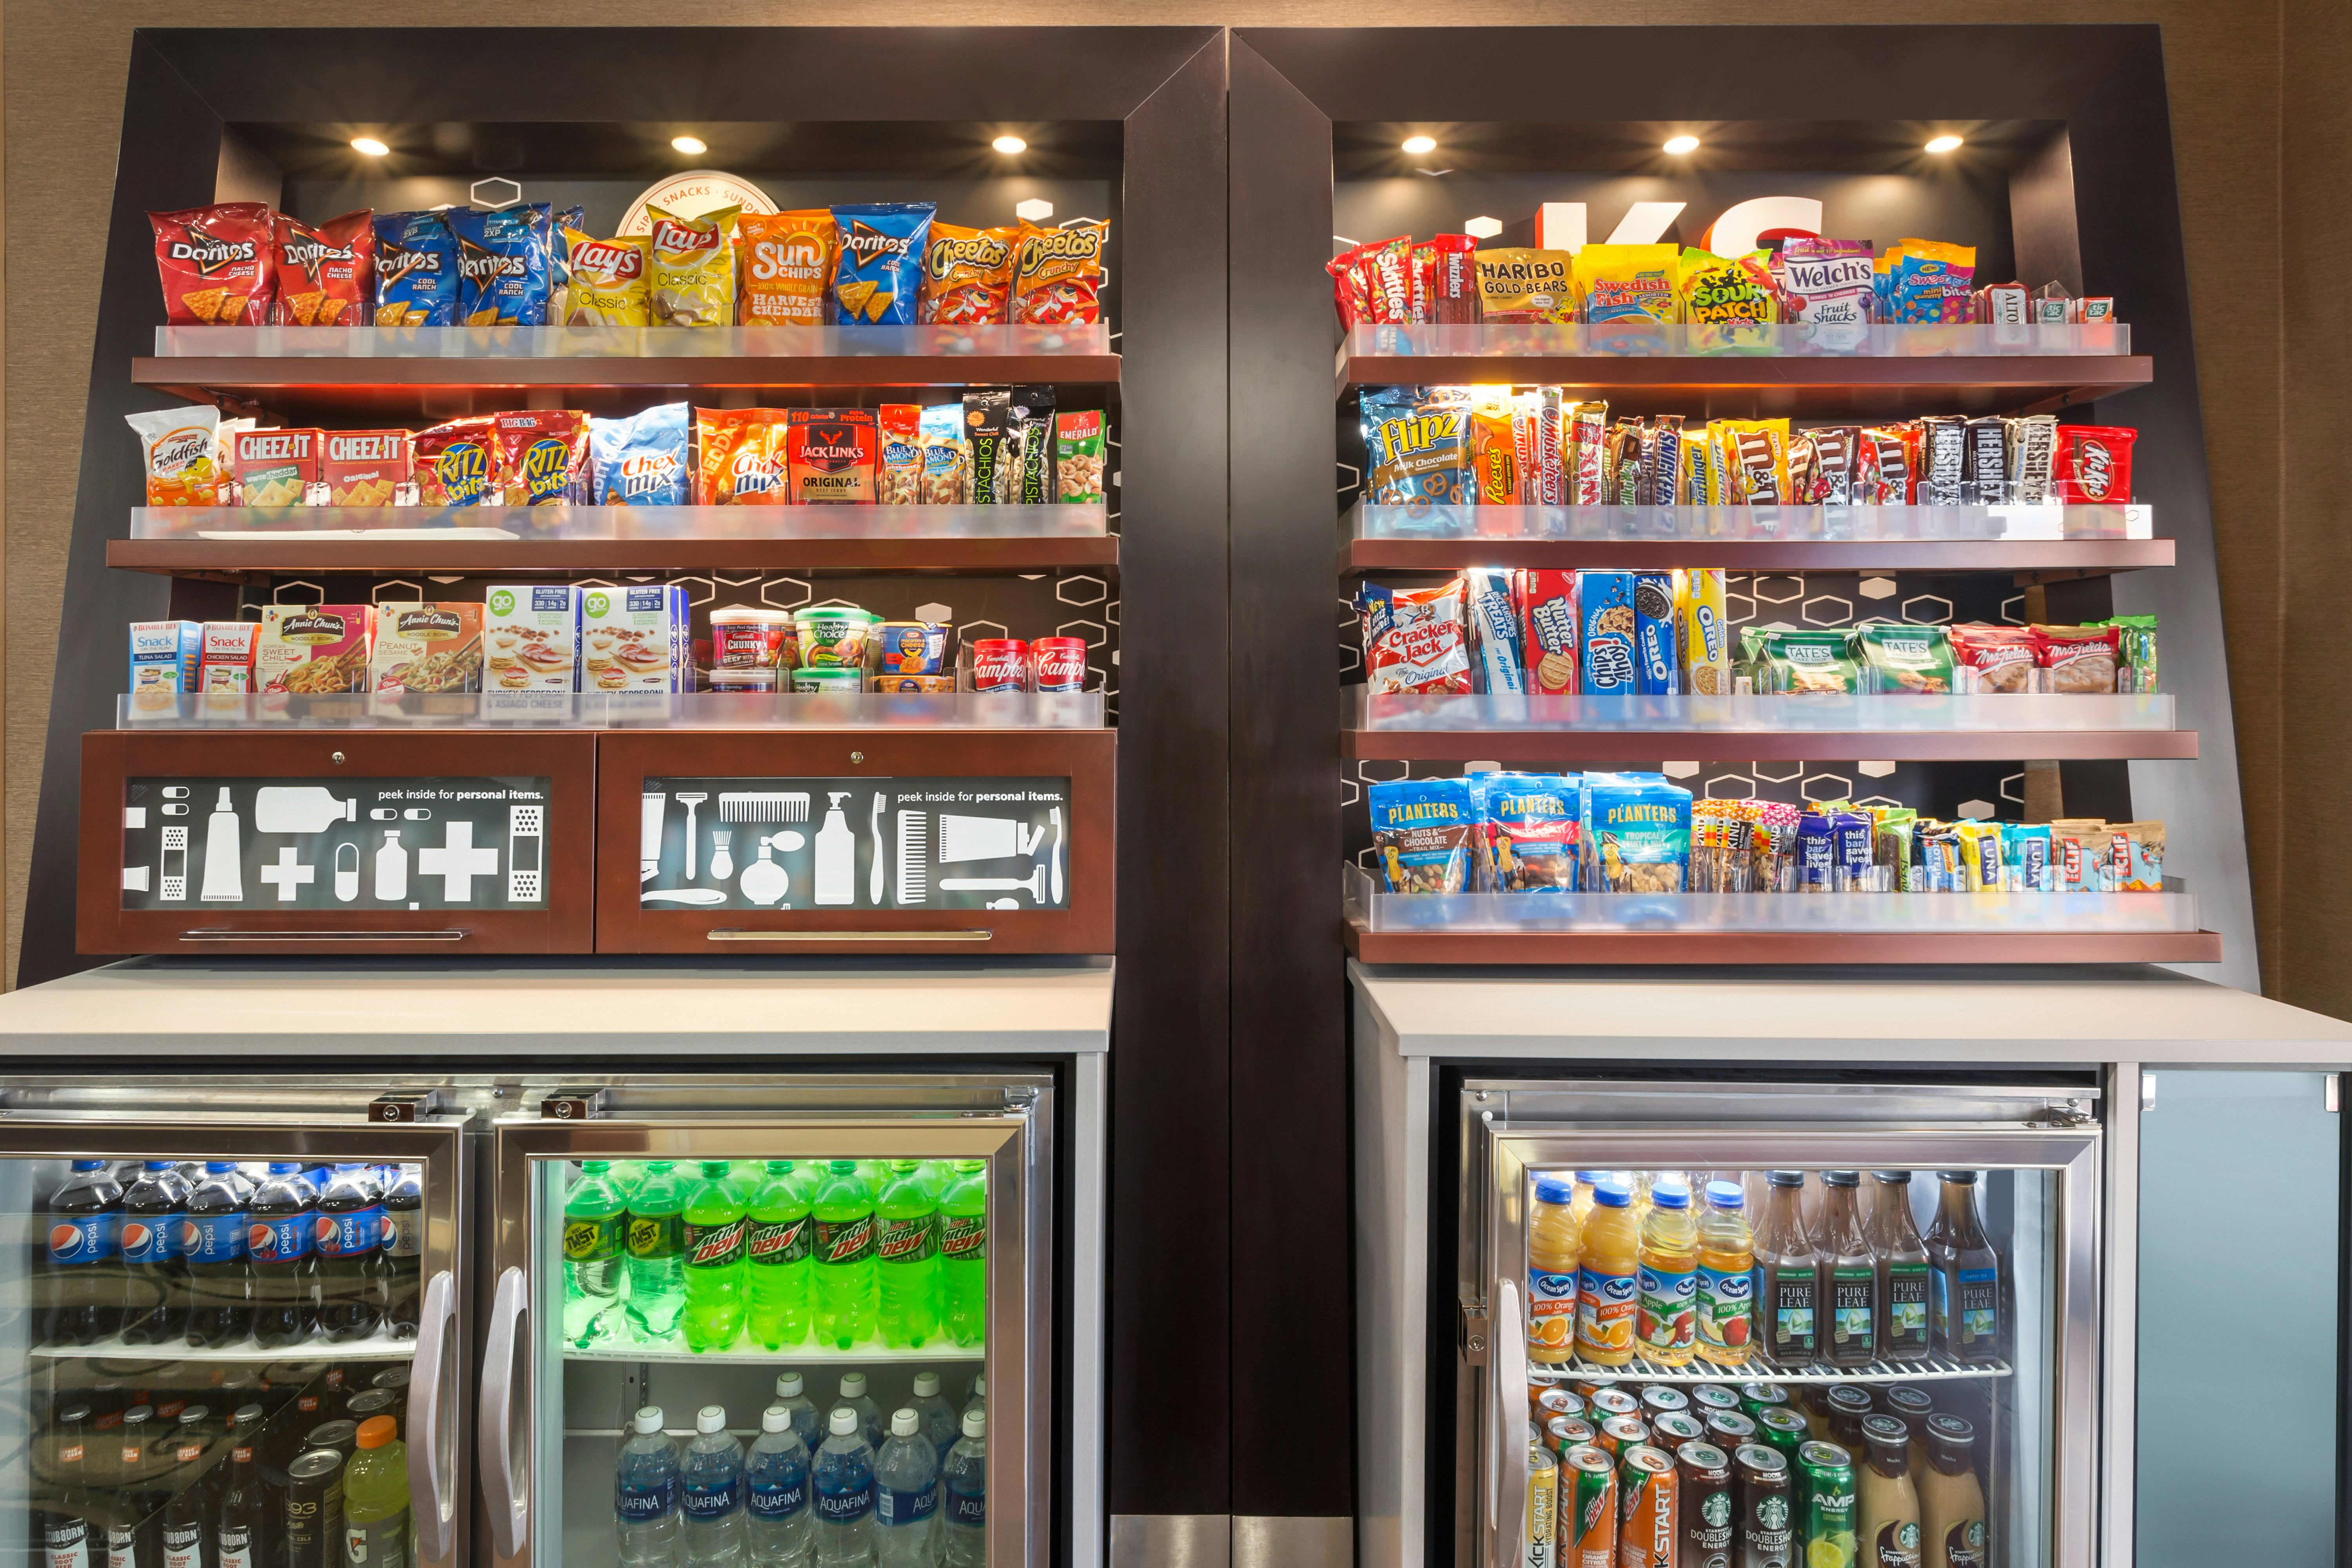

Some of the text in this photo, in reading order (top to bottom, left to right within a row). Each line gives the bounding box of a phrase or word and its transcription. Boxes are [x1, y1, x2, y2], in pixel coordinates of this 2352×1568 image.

[664, 187, 710, 205] SNACKS
[172, 243, 254, 261] Doritos
[842, 234, 910, 254] Doritos
[286, 245, 353, 265] Doritos
[573, 243, 639, 277] Lay's
[1022, 231, 1096, 275] Cheetos
[779, 267, 821, 279] CHIPS
[1040, 262, 1078, 279] Crunchy
[1449, 253, 1463, 298] Twizzlers
[1481, 263, 1564, 279] HARIBO
[1789, 261, 1871, 288] Welch's
[658, 273, 707, 286] Classic
[1376, 253, 1405, 319] Skittles
[1485, 281, 1567, 294] GOLD-BEARS
[1595, 278, 1671, 292] Swedish
[799, 285, 818, 293] GRAIN
[1696, 285, 1761, 305] SOUR
[1923, 287, 1942, 295] mini
[753, 294, 822, 307] HARVEST
[1595, 293, 1635, 307] Fish
[1821, 303, 1851, 314] Fruit
[753, 306, 822, 318] CHEDDAR
[1697, 302, 1766, 323] PATCH
[1814, 311, 1857, 324] Snacks
[1060, 428, 1097, 440] EMERALD
[1379, 413, 1461, 463] Flipz
[799, 446, 864, 458] JACK LINK'S
[520, 445, 568, 480] RITZ
[623, 448, 679, 476] Chex
[1394, 454, 1457, 472] Milk Chocolate
[247, 467, 297, 482] WHITE cheddar
[803, 477, 860, 487] ORIGINAL
[1486, 447, 1505, 504] Reese's
[530, 473, 567, 494] bits
[493, 595, 512, 611] go
[1478, 593, 1508, 640] TREATS
[1491, 591, 1516, 637] RICE KRISPIES
[1587, 606, 1605, 637] ORIGINAL
[284, 618, 343, 630] Annie Chun's
[817, 622, 847, 632] Healthy
[1532, 606, 1562, 655] Butter
[1547, 597, 1574, 649] Nutter
[138, 636, 172, 647] Snack
[210, 637, 245, 647] Snack
[814, 630, 844, 639] Choice
[1390, 622, 1453, 647] Cracker
[1699, 607, 1718, 661] OREO
[728, 641, 761, 650] CHUNKY
[1400, 639, 1441, 663] Jack
[1647, 624, 1668, 681] OREO
[1788, 647, 1829, 658] TATE'S
[1396, 664, 1449, 684] The Original
[1497, 656, 1517, 690] Original
[379, 790, 543, 800] peek inside for personal items.
[898, 791, 1063, 803] peek inside for personal items.
[1389, 803, 1458, 824] PLANTERS
[1608, 806, 1676, 823] PLANTERS
[1405, 836, 1447, 847] CHOCOLATE
[1728, 820, 1740, 849] KIND
[1984, 839, 1996, 881] LUNA
[2066, 840, 2079, 873] CLIF
[890, 1221, 908, 1231] diet
[87, 1223, 99, 1253] pepsi
[156, 1223, 166, 1253] pepsi
[281, 1223, 291, 1254] pepsi
[1541, 1280, 1569, 1293] Ocean Spray
[1723, 1282, 1749, 1294] Ocean Spray
[1780, 1287, 1811, 1297] PURE
[1838, 1287, 1869, 1297] PURE
[1534, 1301, 1573, 1312] 100% Orange
[1719, 1305, 1736, 1313] 100%
[751, 1488, 801, 1507] AQUAFINA
[820, 1490, 869, 1513] AQUAFINA
[1812, 1493, 1855, 1507] AMP
[347, 1529, 367, 1564] G
[1757, 1543, 1787, 1552] ENERGY
